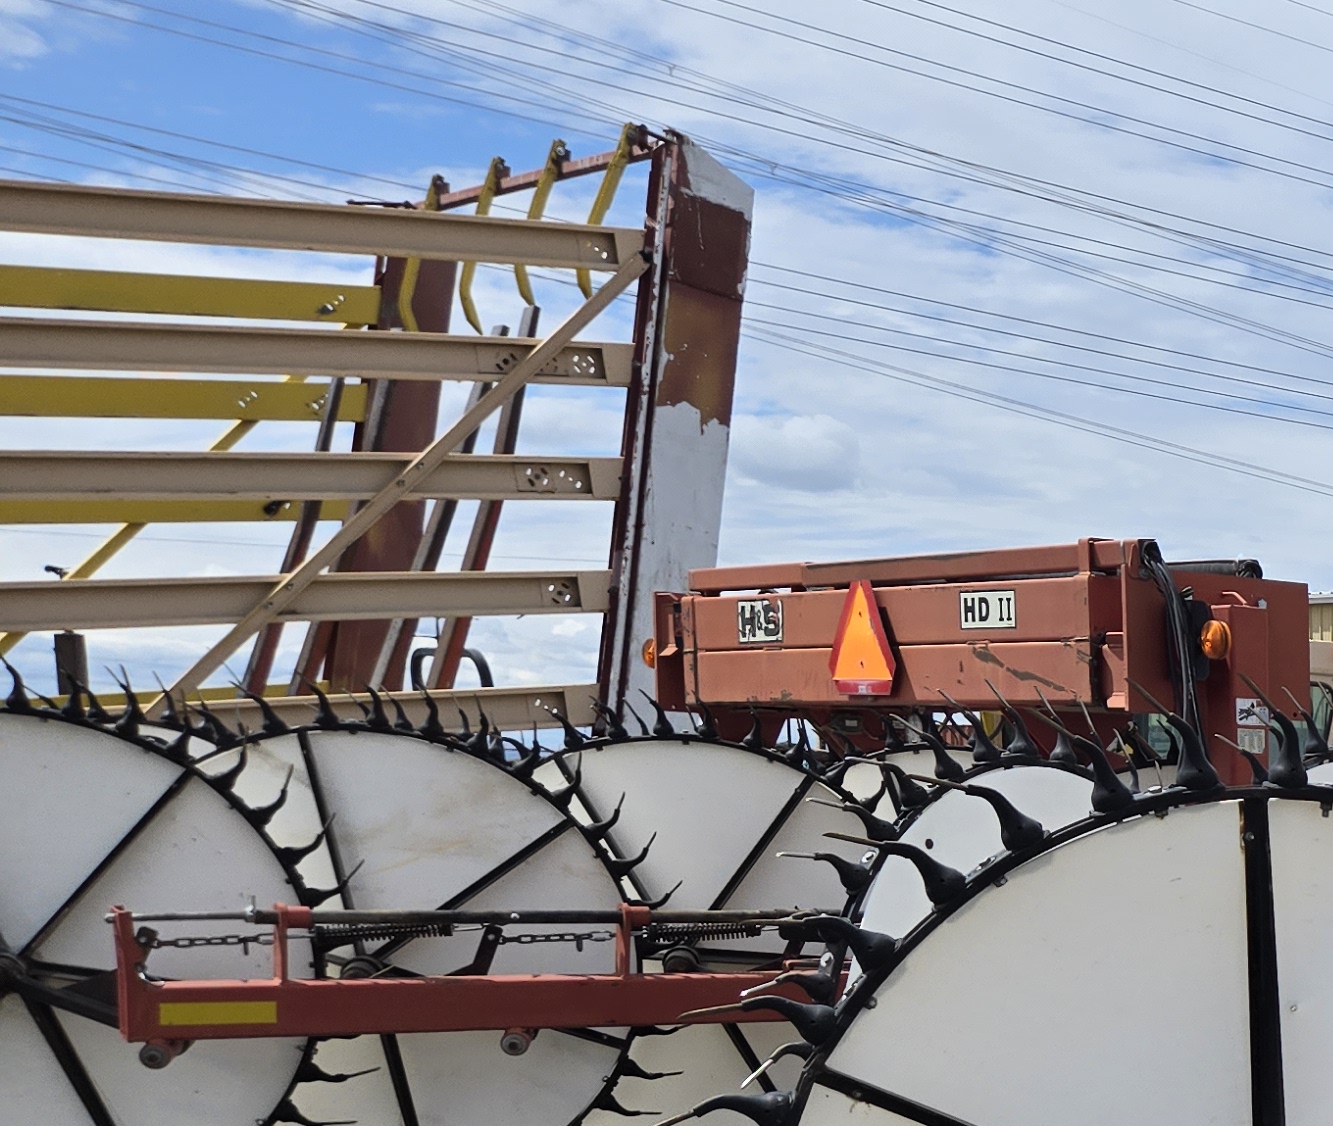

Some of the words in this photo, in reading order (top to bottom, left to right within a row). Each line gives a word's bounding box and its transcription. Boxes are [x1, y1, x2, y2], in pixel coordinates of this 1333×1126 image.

[741, 604, 780, 638] H&S
[963, 596, 990, 623] HD
[998, 597, 1013, 622] II
